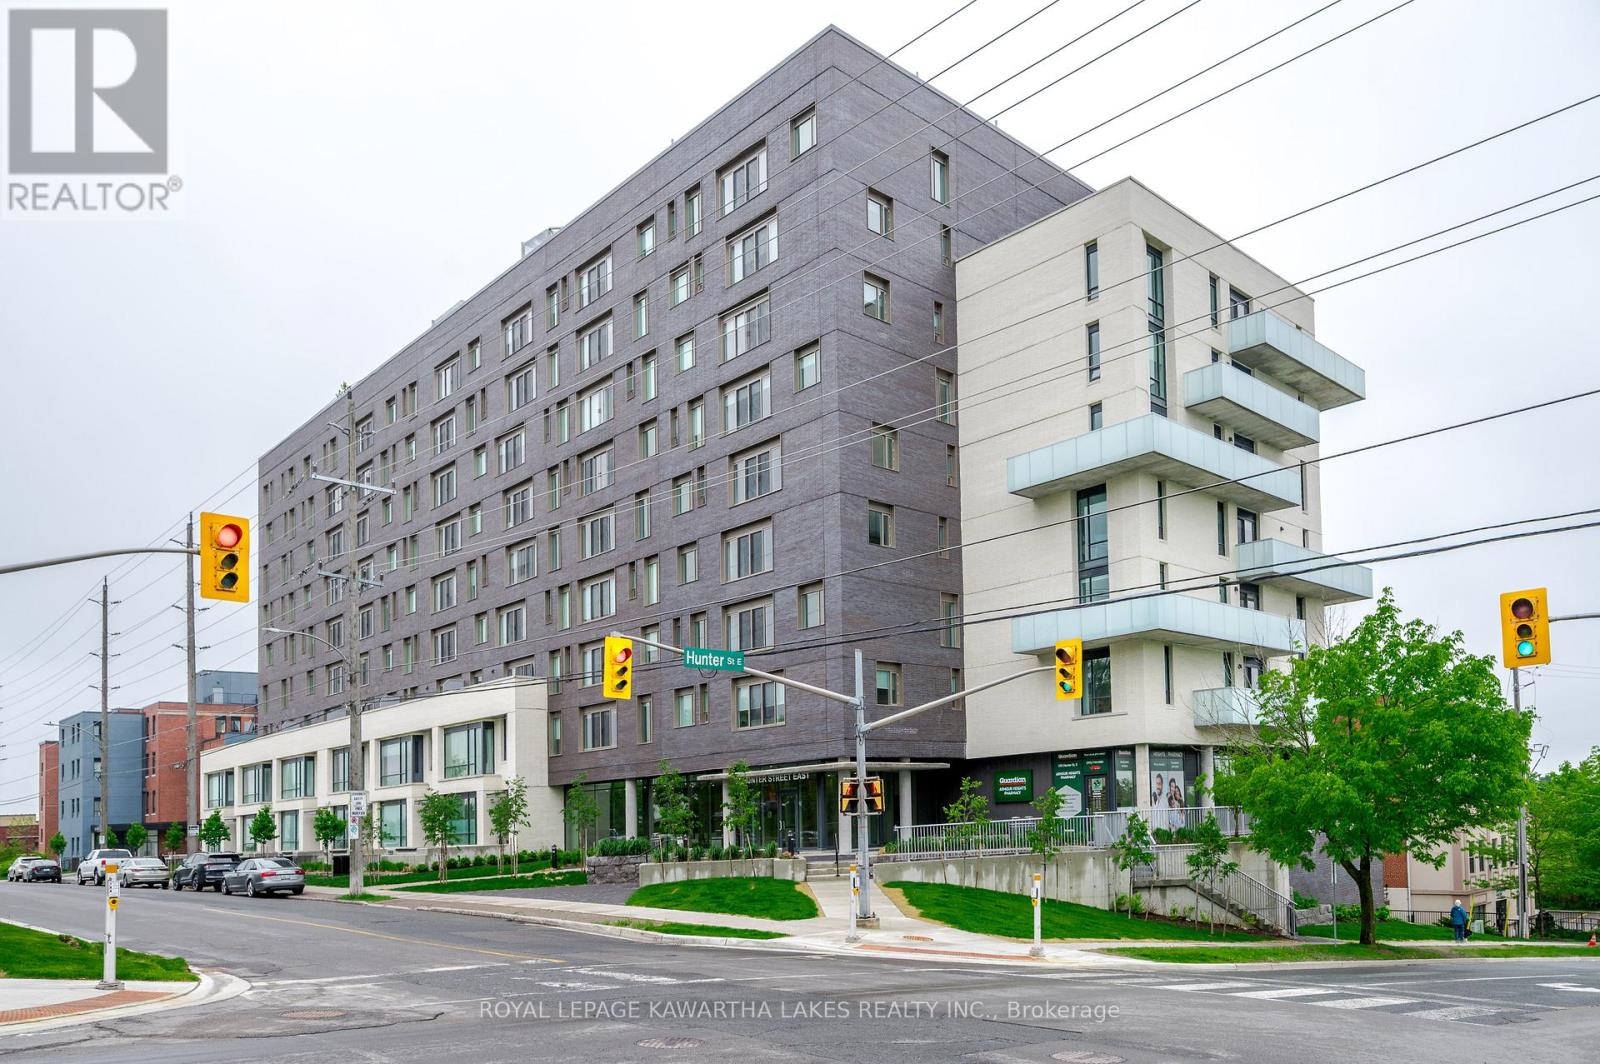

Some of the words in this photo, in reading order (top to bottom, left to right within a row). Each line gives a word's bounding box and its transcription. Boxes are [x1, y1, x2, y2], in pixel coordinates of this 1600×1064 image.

[686, 650, 725, 667] Hunter
[727, 657, 735, 666] St
[736, 658, 742, 666] E
[767, 773, 791, 783] STREET
[792, 772, 810, 781] EAST
[999, 776, 1027, 784] Guardian
